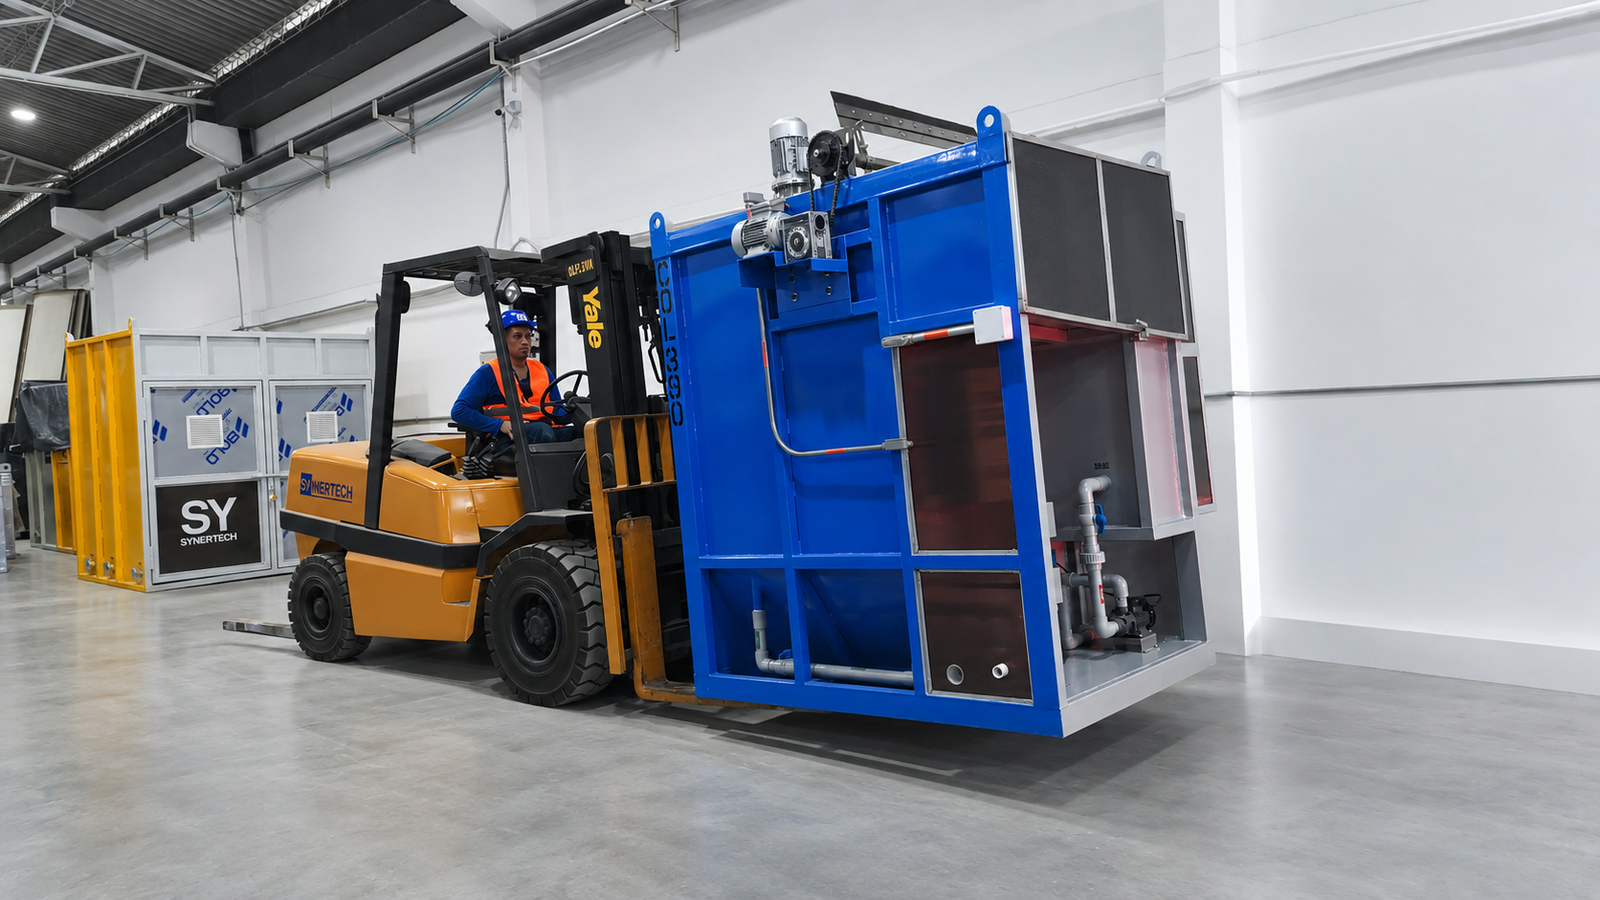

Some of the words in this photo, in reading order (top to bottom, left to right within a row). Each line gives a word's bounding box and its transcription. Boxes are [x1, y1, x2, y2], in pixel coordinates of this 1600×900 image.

[582, 285, 605, 349] Yale
[181, 496, 237, 535] SY
[180, 532, 238, 547] SYNERTECH
